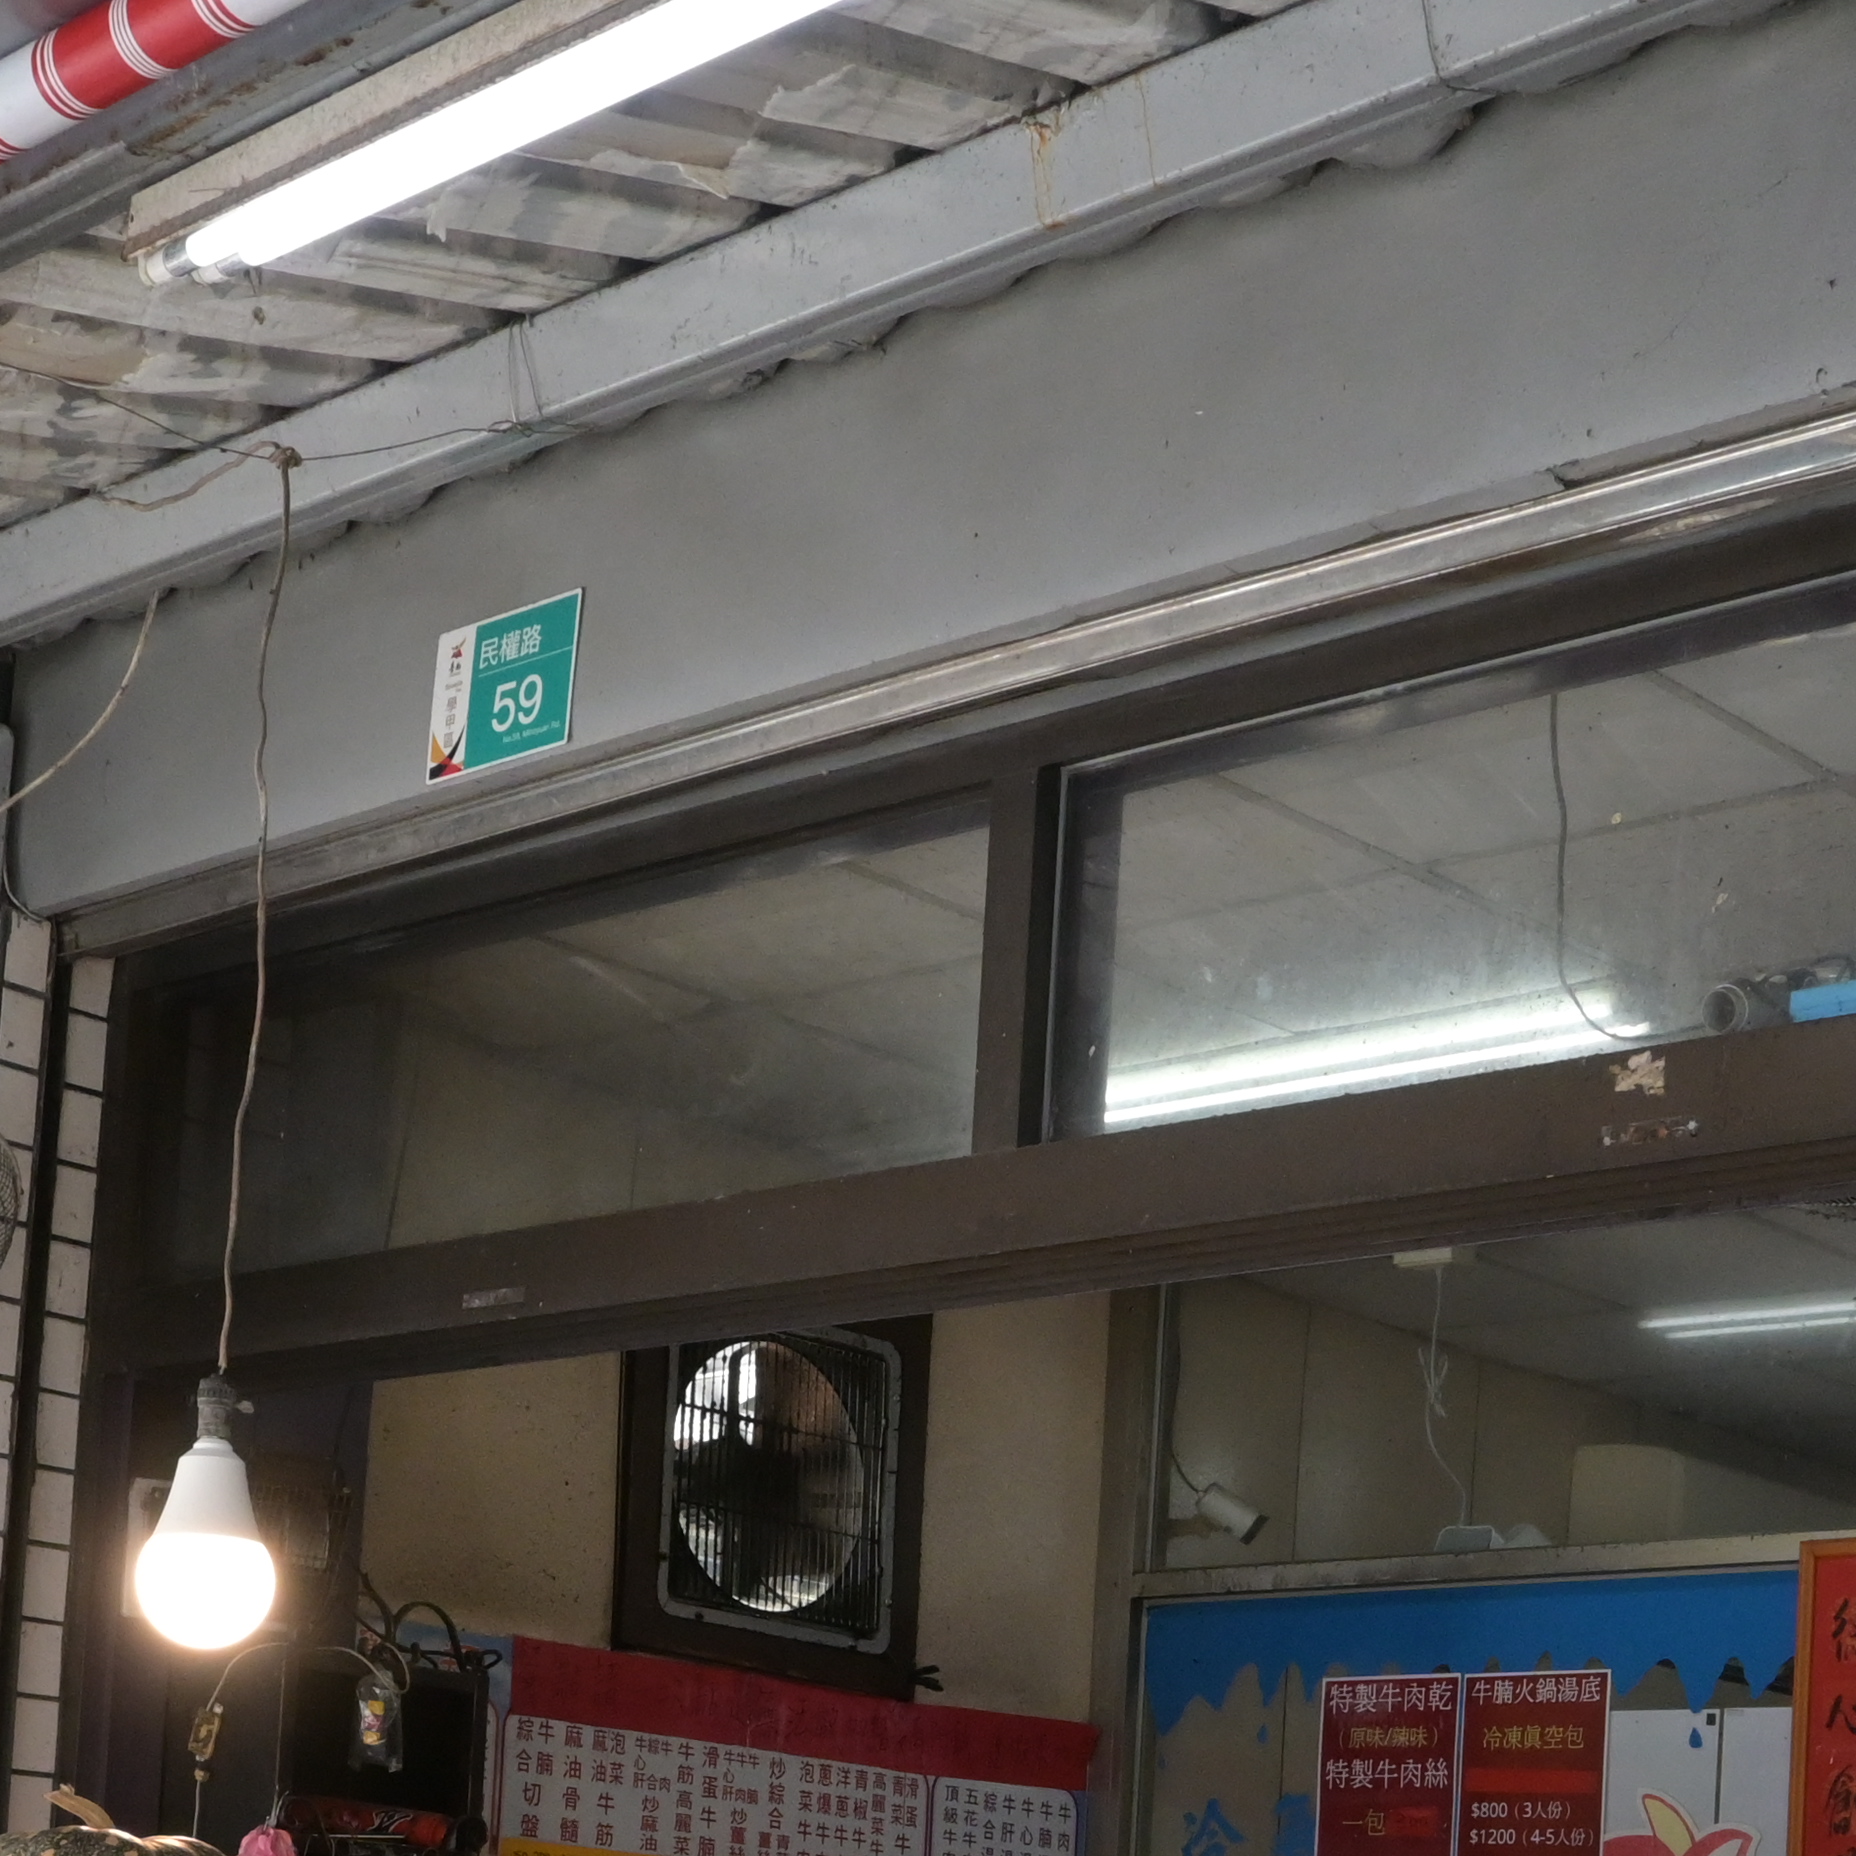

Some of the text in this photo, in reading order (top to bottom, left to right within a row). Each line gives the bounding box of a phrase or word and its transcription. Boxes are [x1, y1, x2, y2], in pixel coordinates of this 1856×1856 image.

[479, 624, 542, 669] 民權路
[491, 674, 543, 732] 59
[1329, 1682, 1453, 1714] 特製牛肉乾
[1471, 1676, 1601, 1706] 牛腩火鍋湯底
[1325, 1756, 1449, 1790] 特製牛肉絲
[1342, 1808, 1385, 1836] 一包
